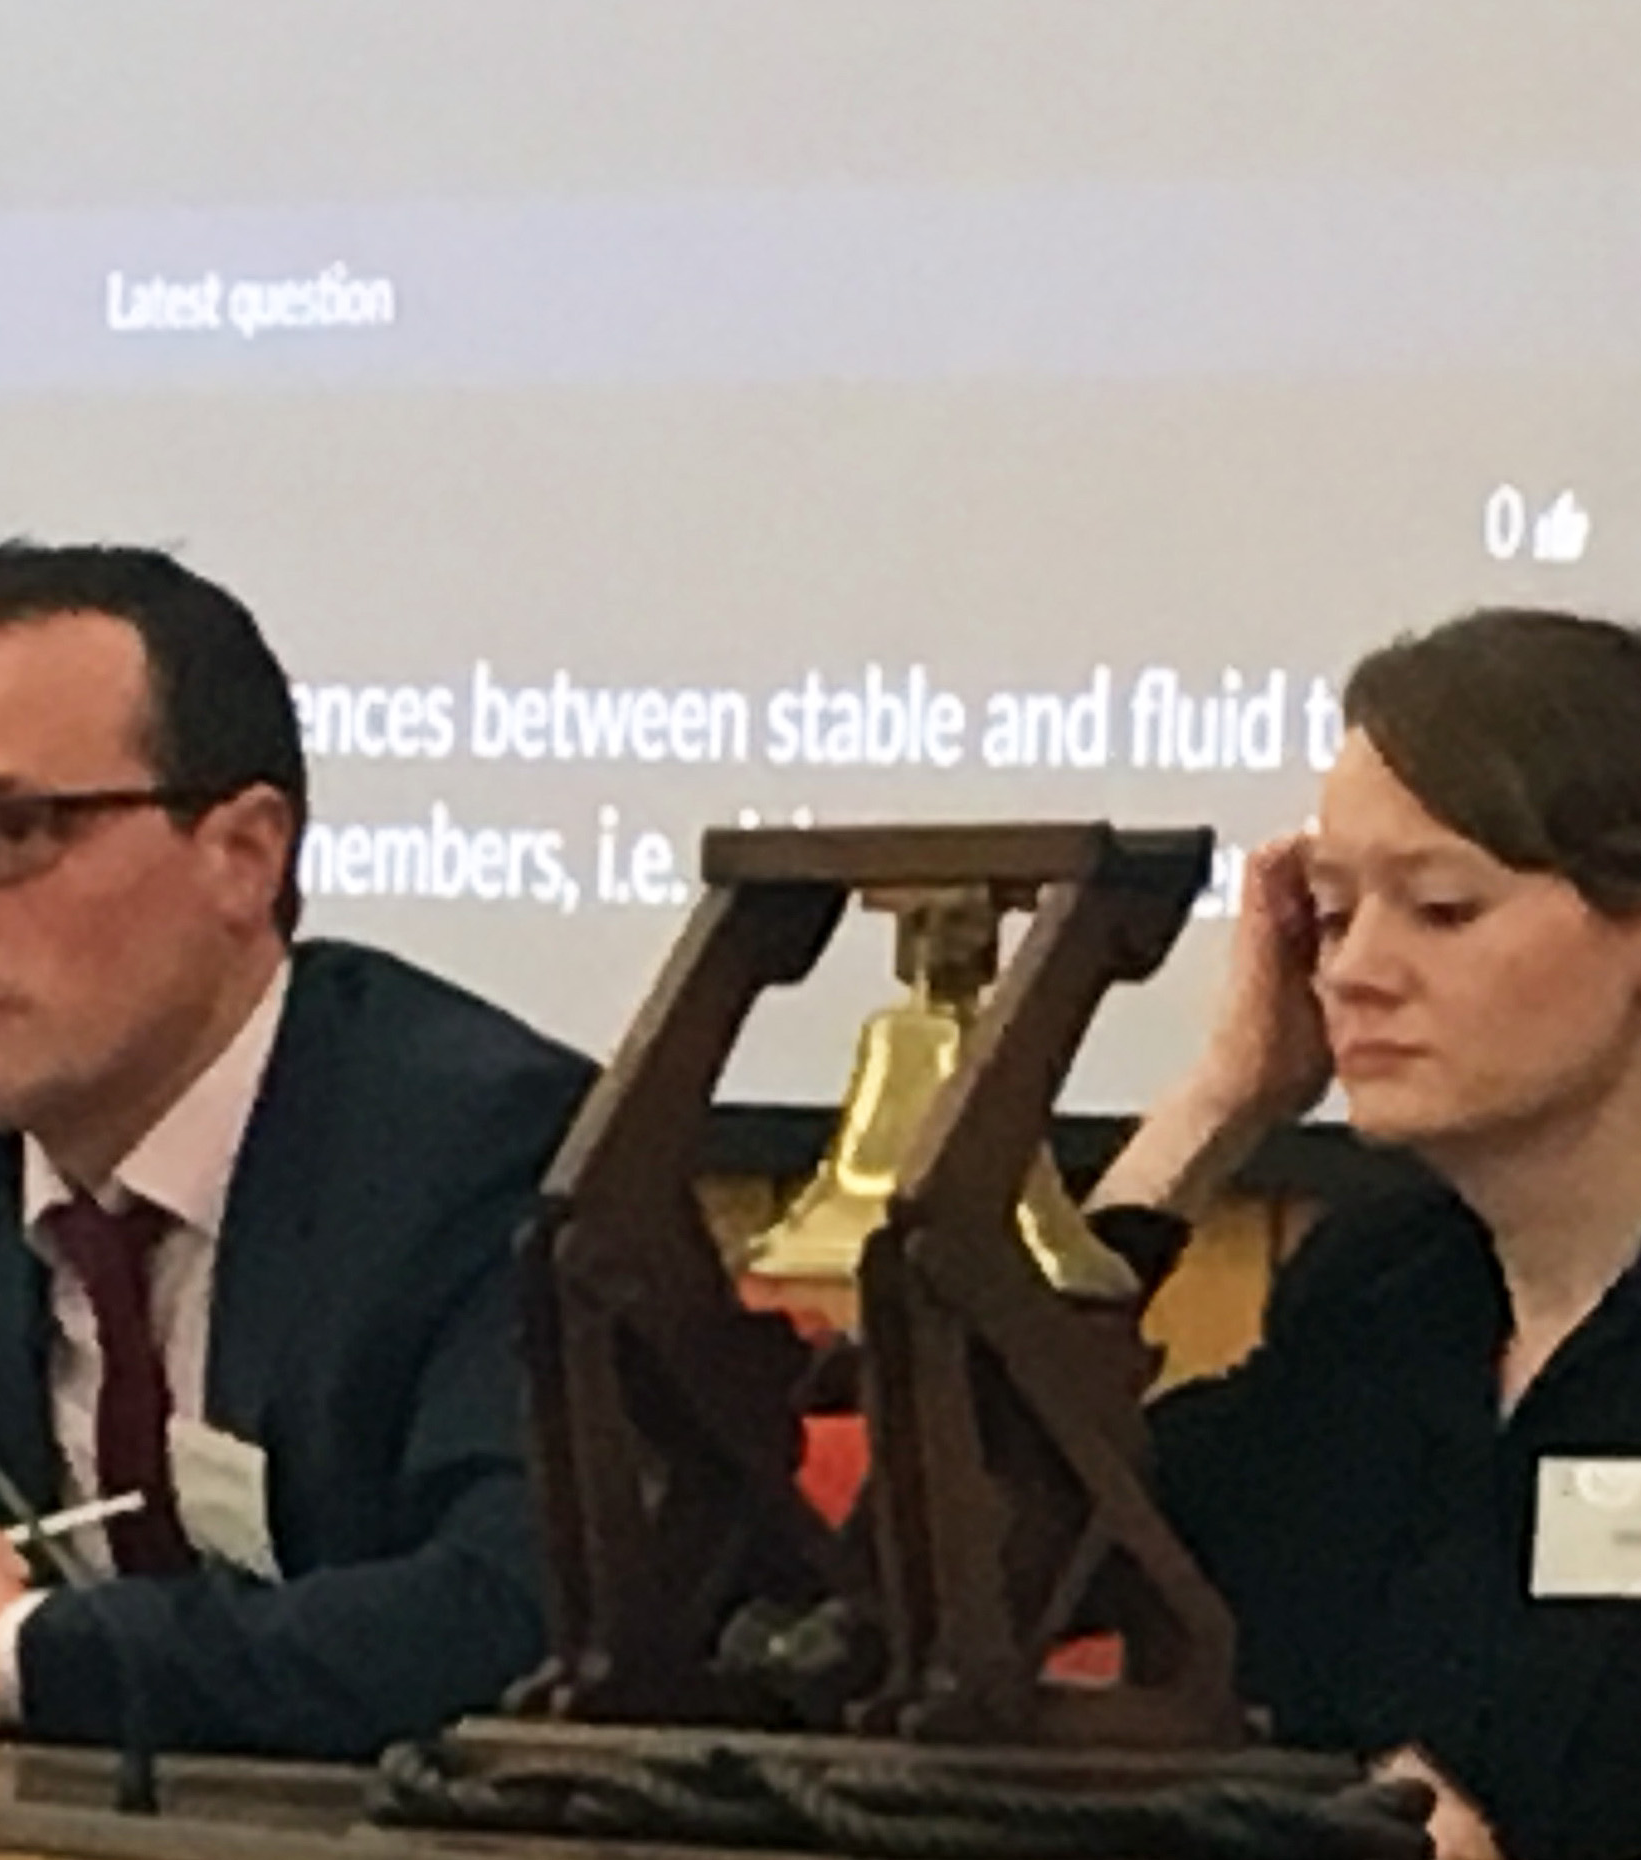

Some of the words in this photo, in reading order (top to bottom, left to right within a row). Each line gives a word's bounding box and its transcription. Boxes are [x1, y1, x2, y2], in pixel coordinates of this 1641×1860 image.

[106, 270, 221, 330] Latest
[228, 260, 395, 339] question
[1485, 483, 1525, 560] 0
[471, 659, 749, 762] between
[767, 661, 965, 767] stable
[982, 662, 1111, 768] and
[1131, 664, 1286, 772] fluid
[598, 804, 689, 904] i.e.
